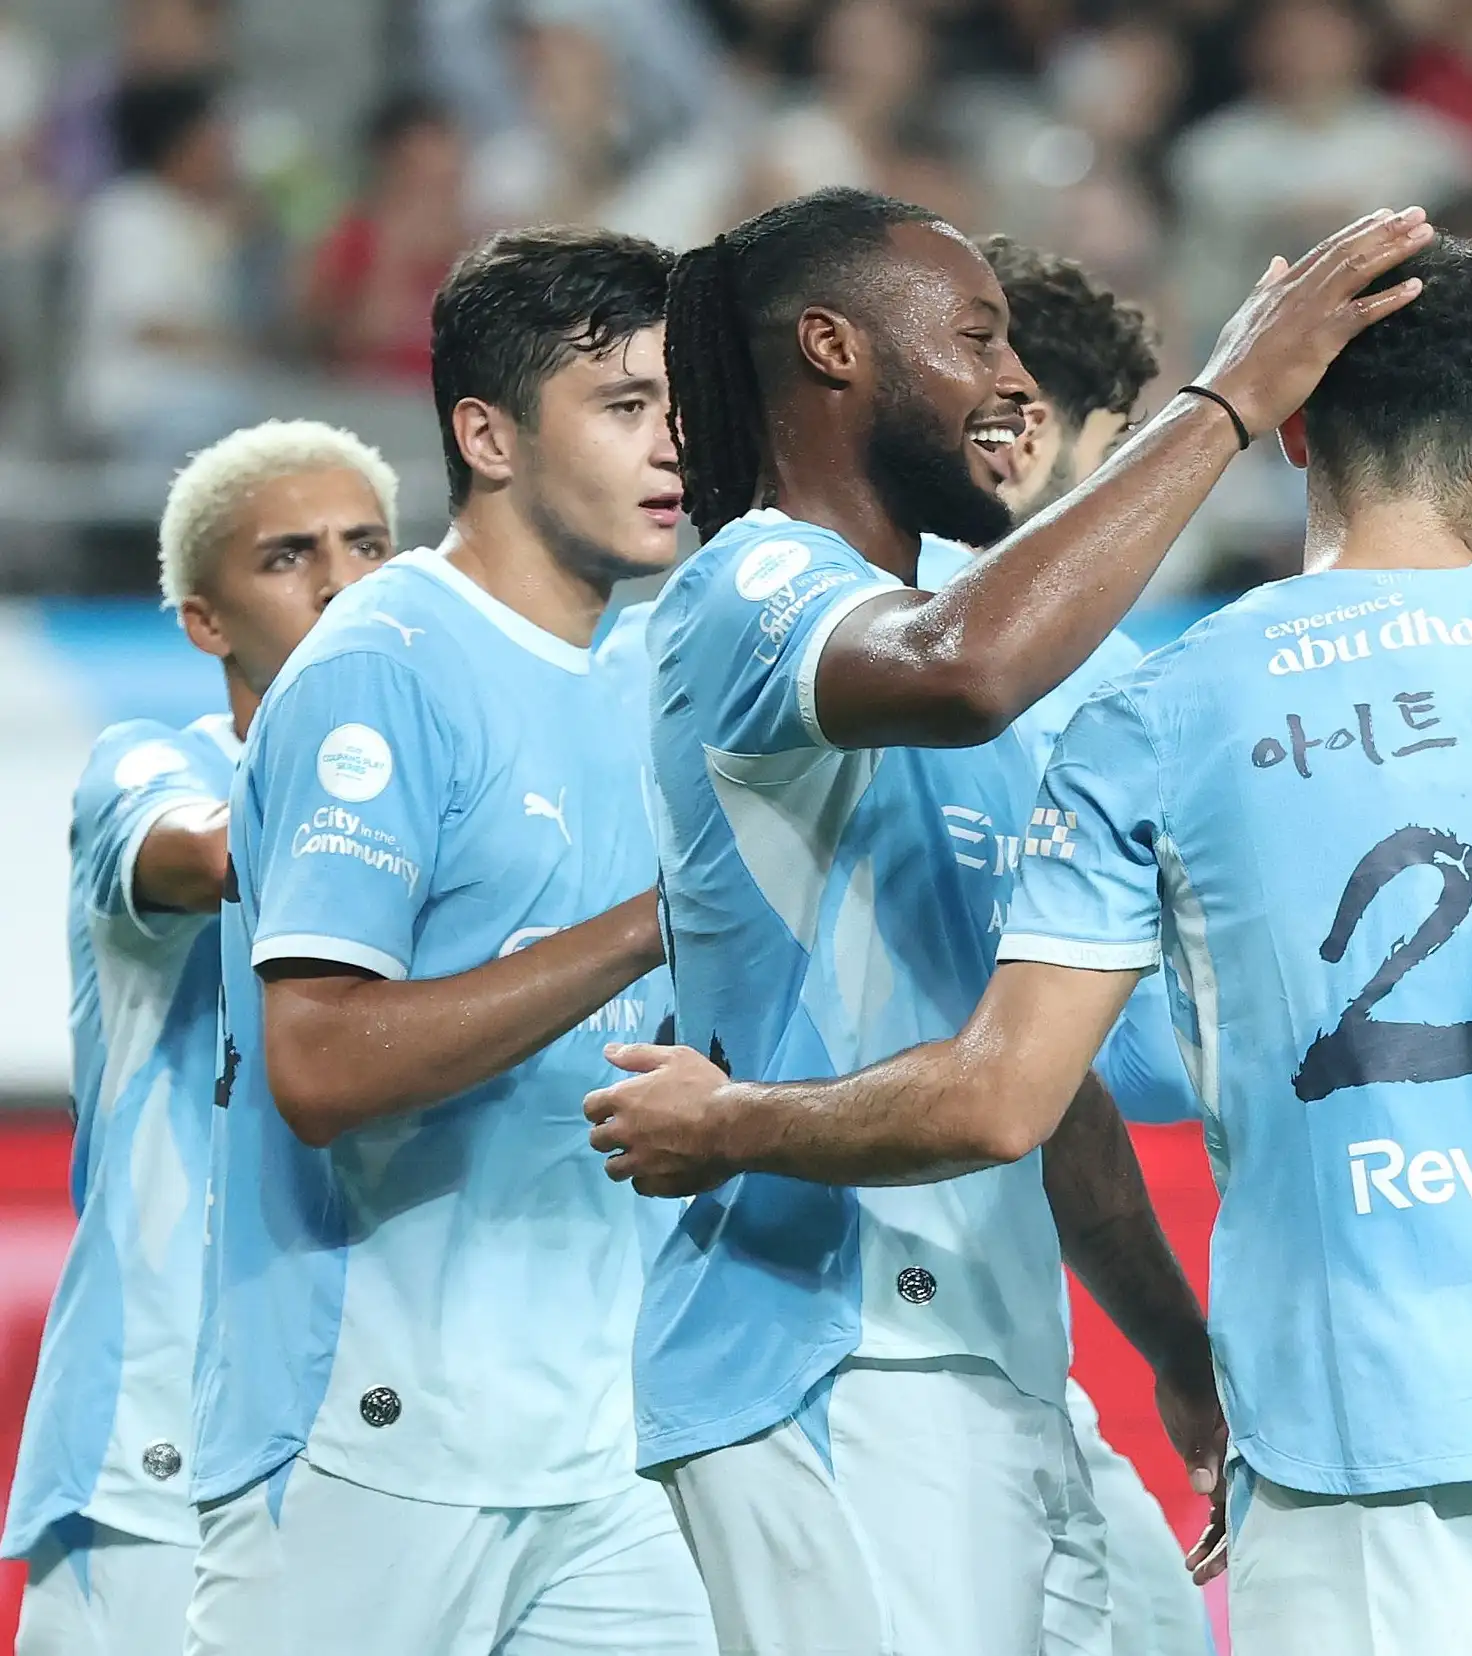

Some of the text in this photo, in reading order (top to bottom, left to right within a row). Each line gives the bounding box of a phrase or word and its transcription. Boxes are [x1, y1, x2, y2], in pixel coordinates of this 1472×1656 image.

[1264, 592, 1405, 640] experience
[1267, 629, 1373, 677] abu
[1251, 691, 1458, 779] 아이트
[313, 804, 397, 847] City in the
[291, 822, 420, 899] Community
